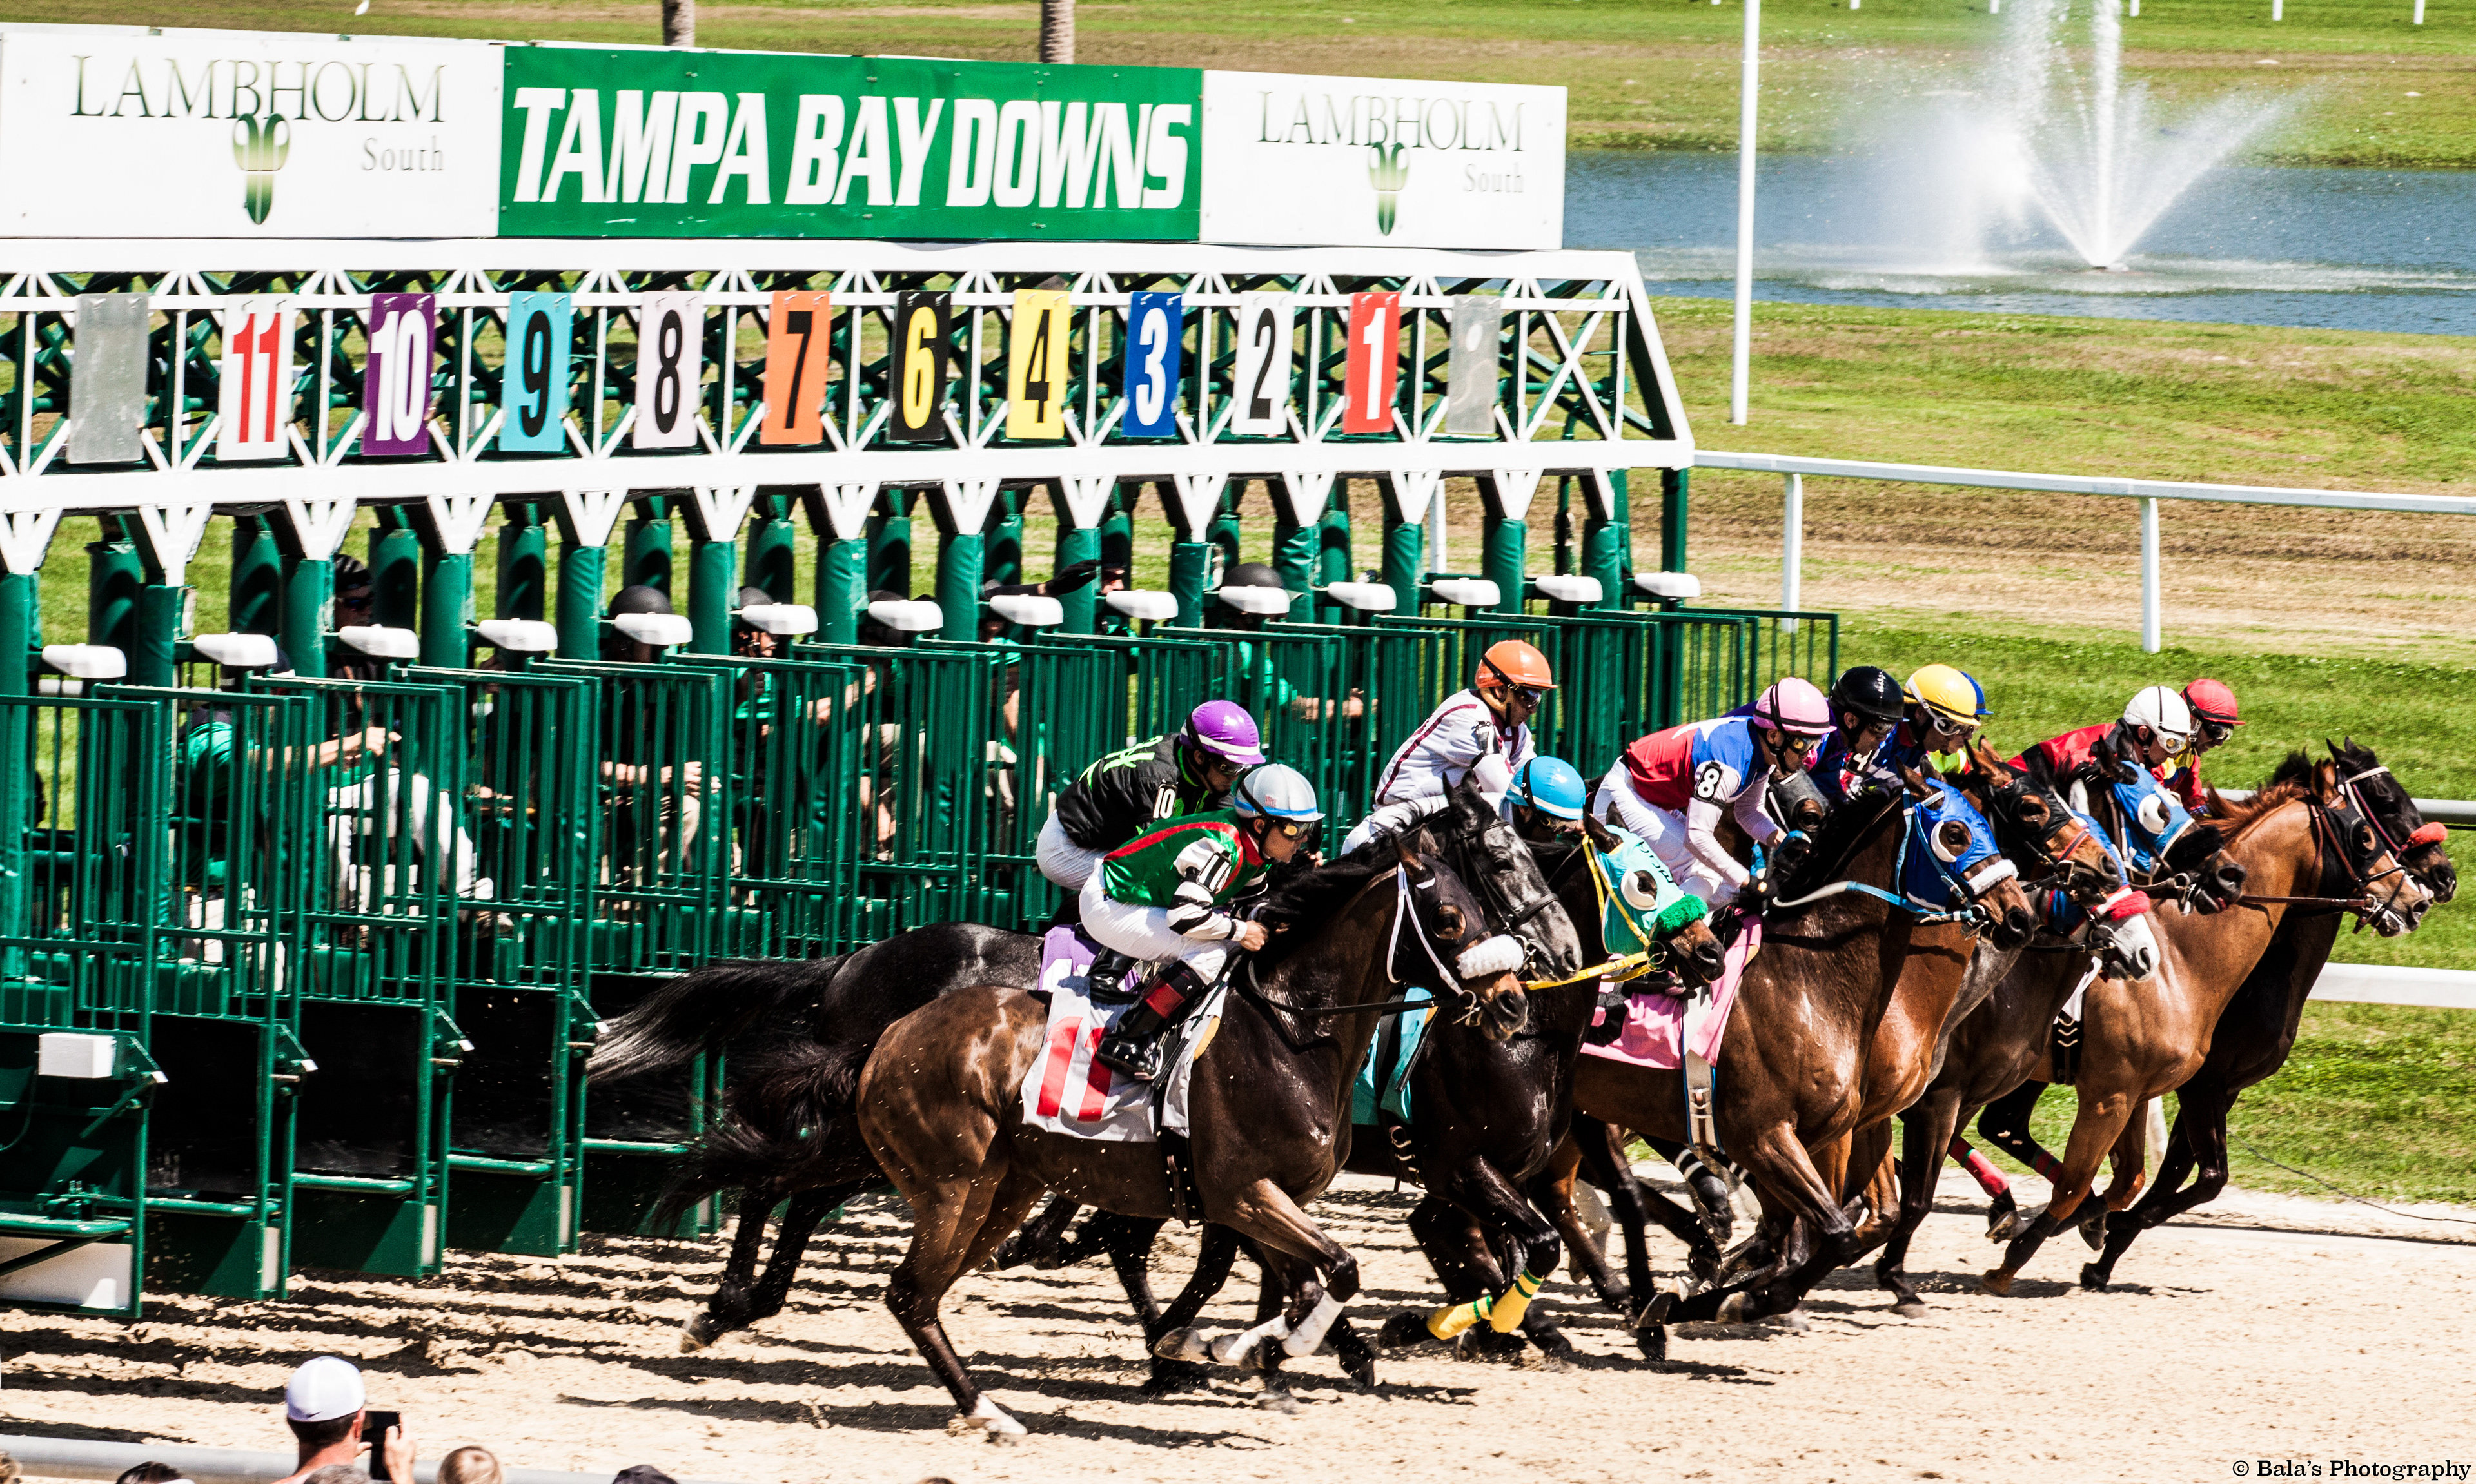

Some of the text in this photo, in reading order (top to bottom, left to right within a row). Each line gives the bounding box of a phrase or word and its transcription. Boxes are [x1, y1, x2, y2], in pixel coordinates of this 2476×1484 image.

[70, 55, 447, 122] LAMBHOLM
[1257, 91, 1525, 151] LAMBHOLM
[361, 137, 444, 171] South
[513, 88, 1192, 208] TAMPA BAY DOWNS
[1464, 164, 1524, 193] South
[232, 313, 281, 444] 11
[370, 309, 427, 442] 10
[520, 310, 552, 438] 9
[654, 309, 682, 434] 8
[785, 311, 814, 429] 7
[903, 306, 937, 430] 6
[1024, 309, 1051, 424] 4
[1135, 307, 1169, 426] 3
[1249, 308, 1276, 420] 2
[1362, 307, 1386, 420] 1
[1476, 725, 1495, 754] 7
[1698, 768, 1720, 798] 8
[1153, 788, 1176, 819] 10
[1199, 854, 1230, 890] 11
[1036, 1016, 1112, 1122] 11
